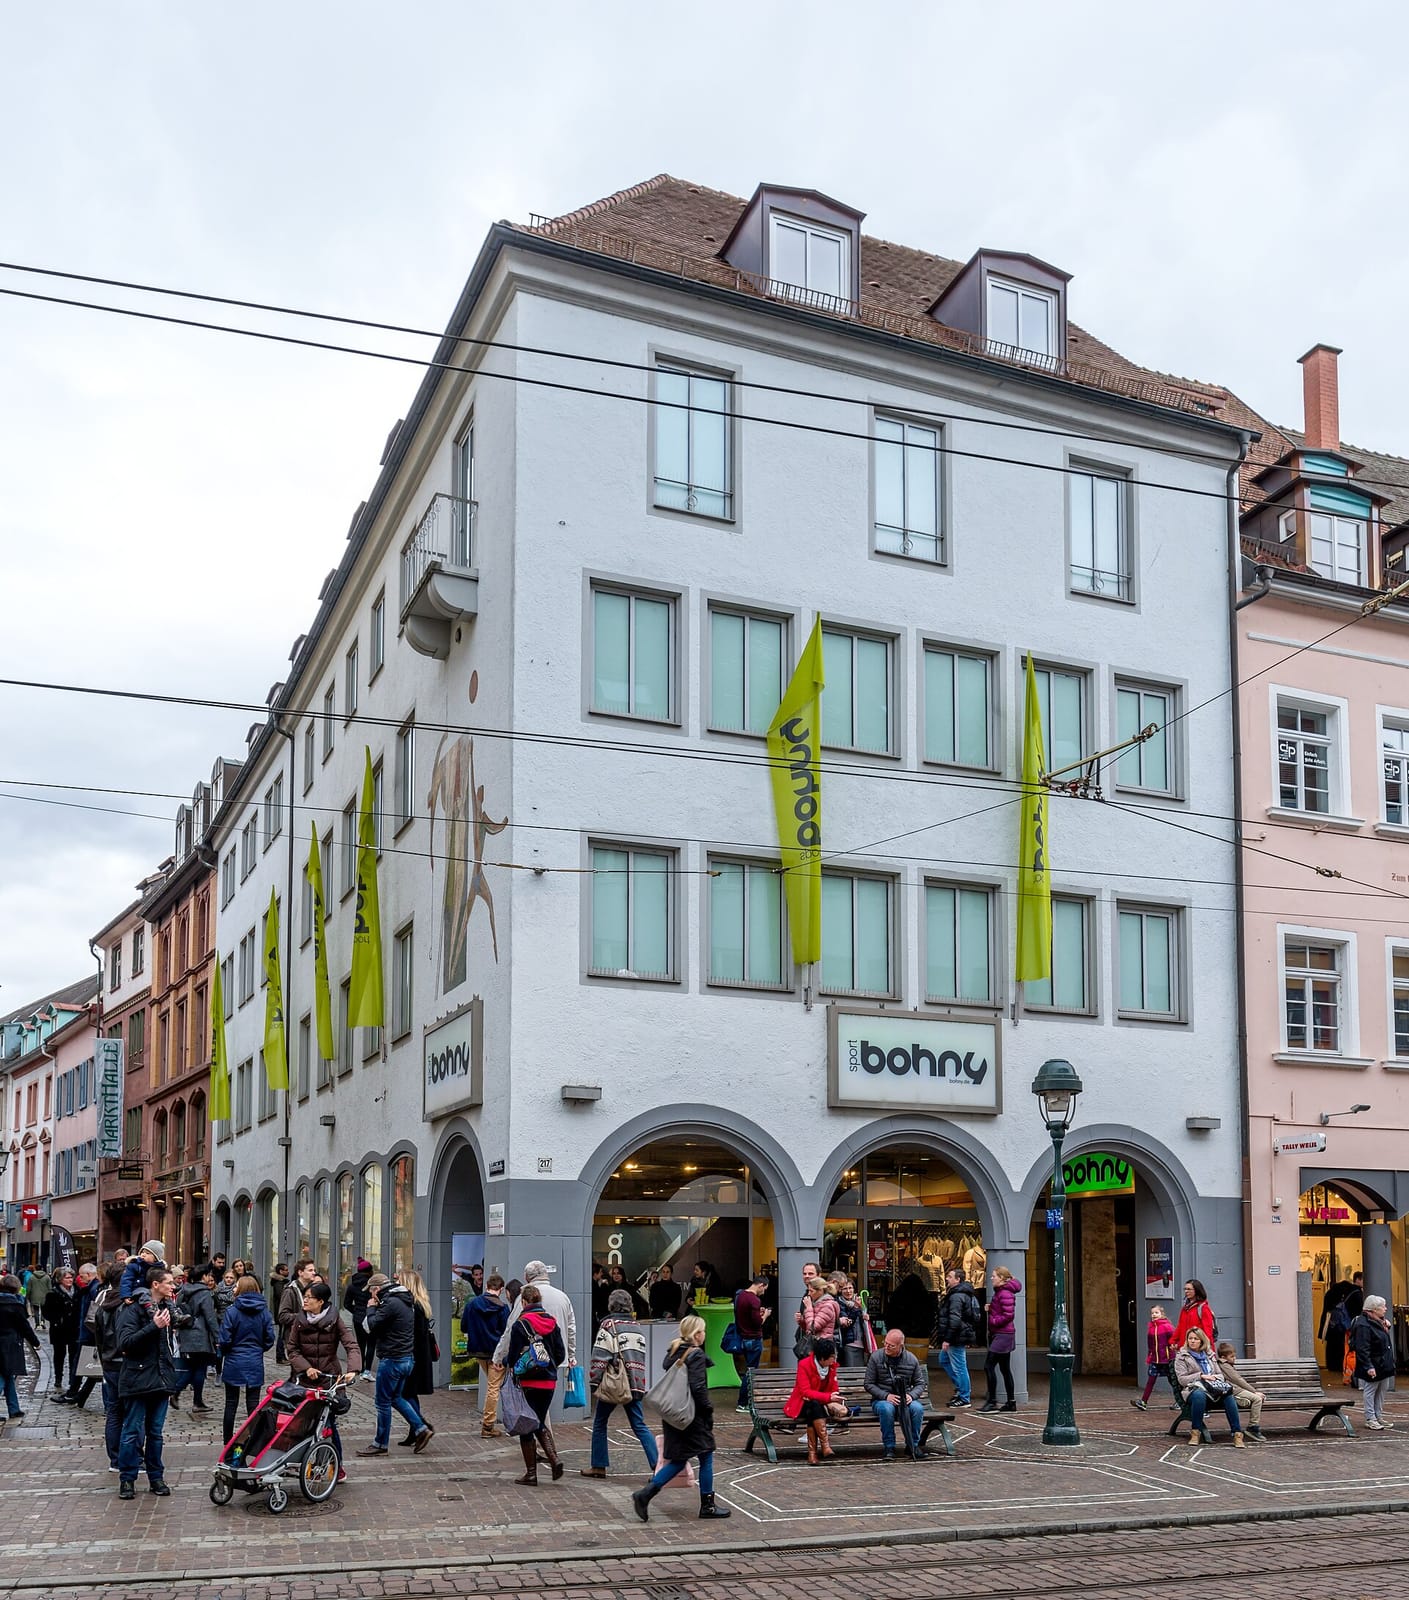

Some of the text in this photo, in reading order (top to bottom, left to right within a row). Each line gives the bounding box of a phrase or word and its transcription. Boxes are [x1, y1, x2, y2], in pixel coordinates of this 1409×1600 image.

[431, 1041, 470, 1084] bohny
[847, 1039, 860, 1072] sport
[860, 1040, 988, 1085] bohny
[101, 1042, 119, 1152] MARKTHALLE
[540, 1159, 550, 1168] 217
